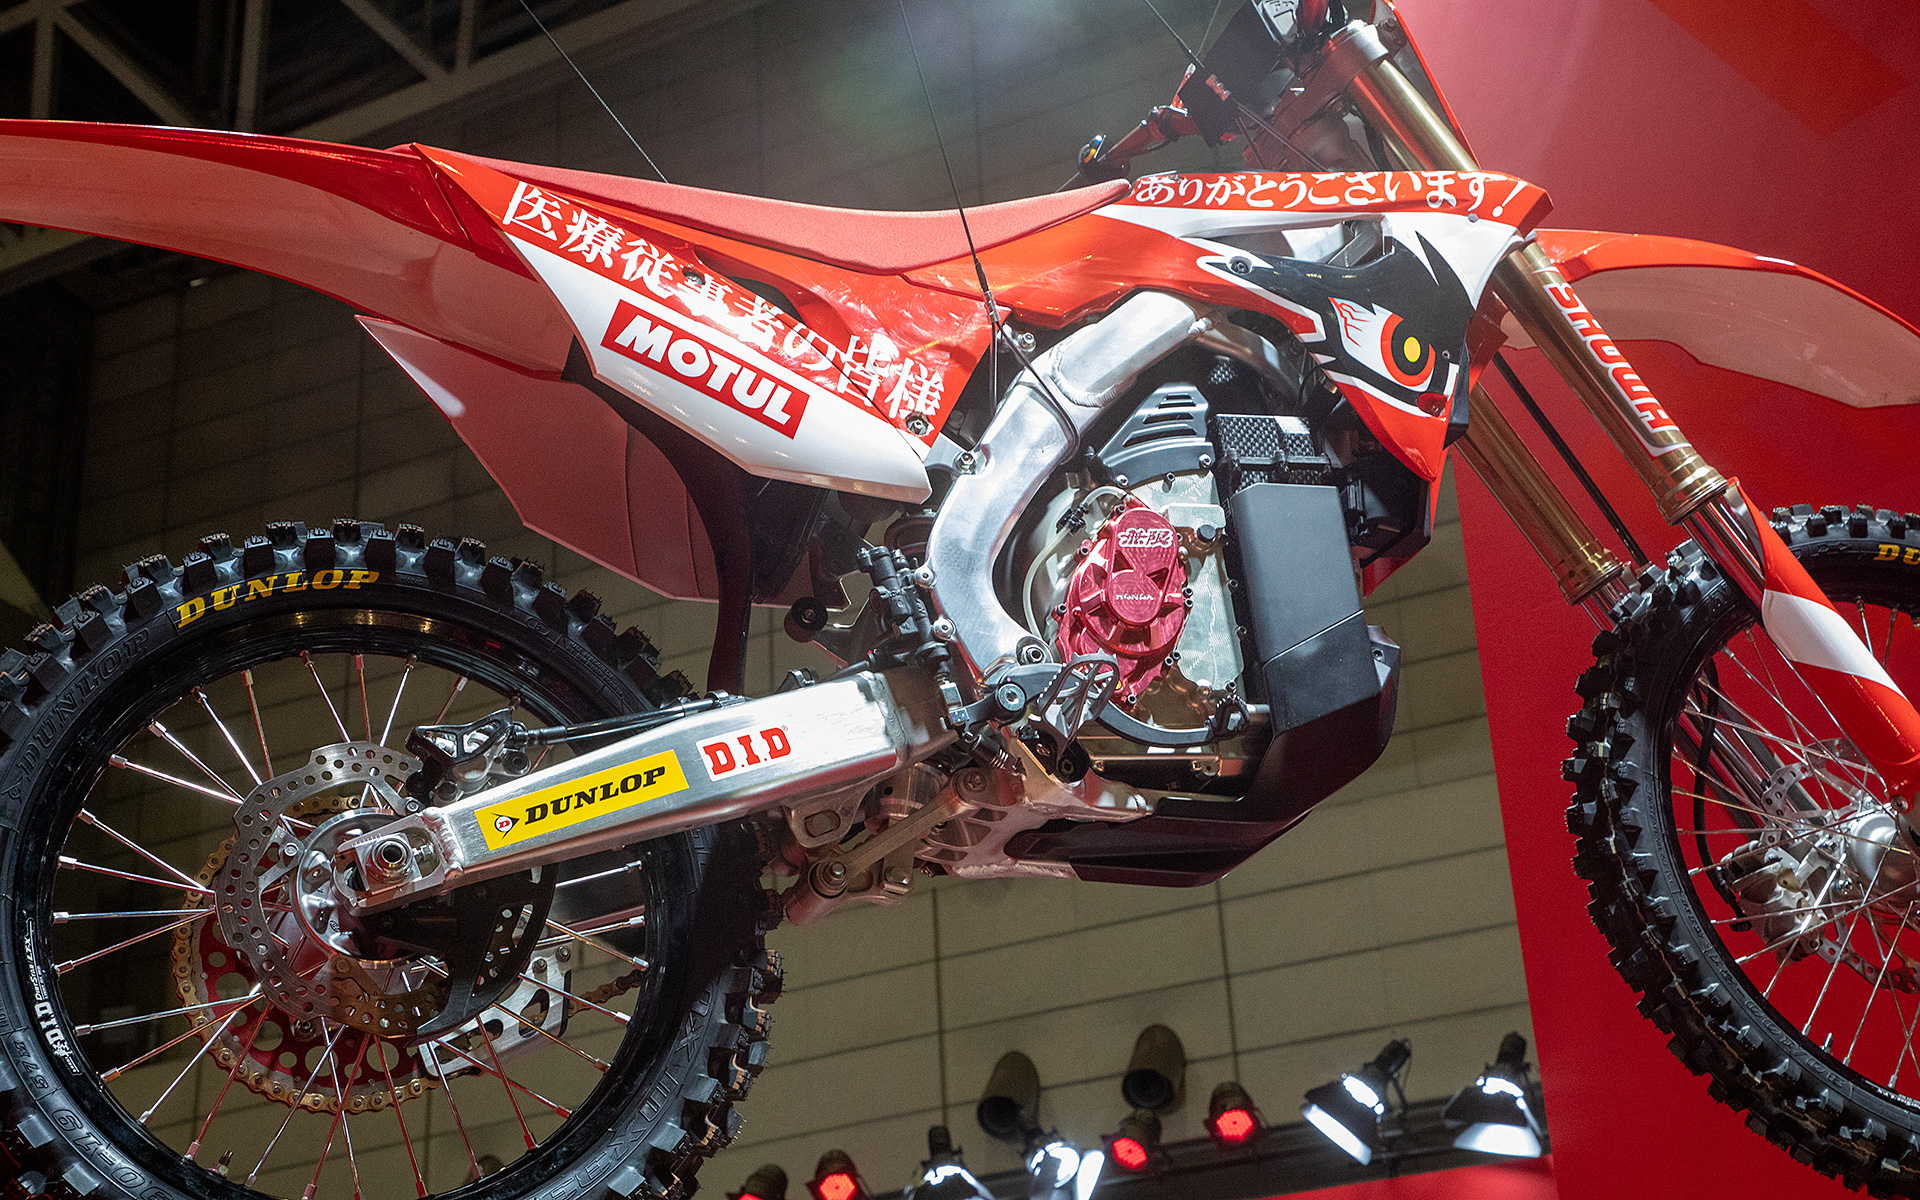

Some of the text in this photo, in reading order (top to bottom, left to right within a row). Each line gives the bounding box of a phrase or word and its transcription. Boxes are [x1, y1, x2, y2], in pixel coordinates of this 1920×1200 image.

[502, 181, 944, 434] 医療従事者の皆様
[614, 314, 792, 425] MOTUL
[1543, 282, 1680, 433] SHOWA
[1117, 527, 1174, 548] 無限
[176, 569, 380, 629] DUNLOP
[1115, 591, 1155, 601] HONDA
[16, 628, 150, 782] DUNLOP
[524, 765, 666, 826] DUNLOP
[34, 1001, 65, 1045] D.I.D
